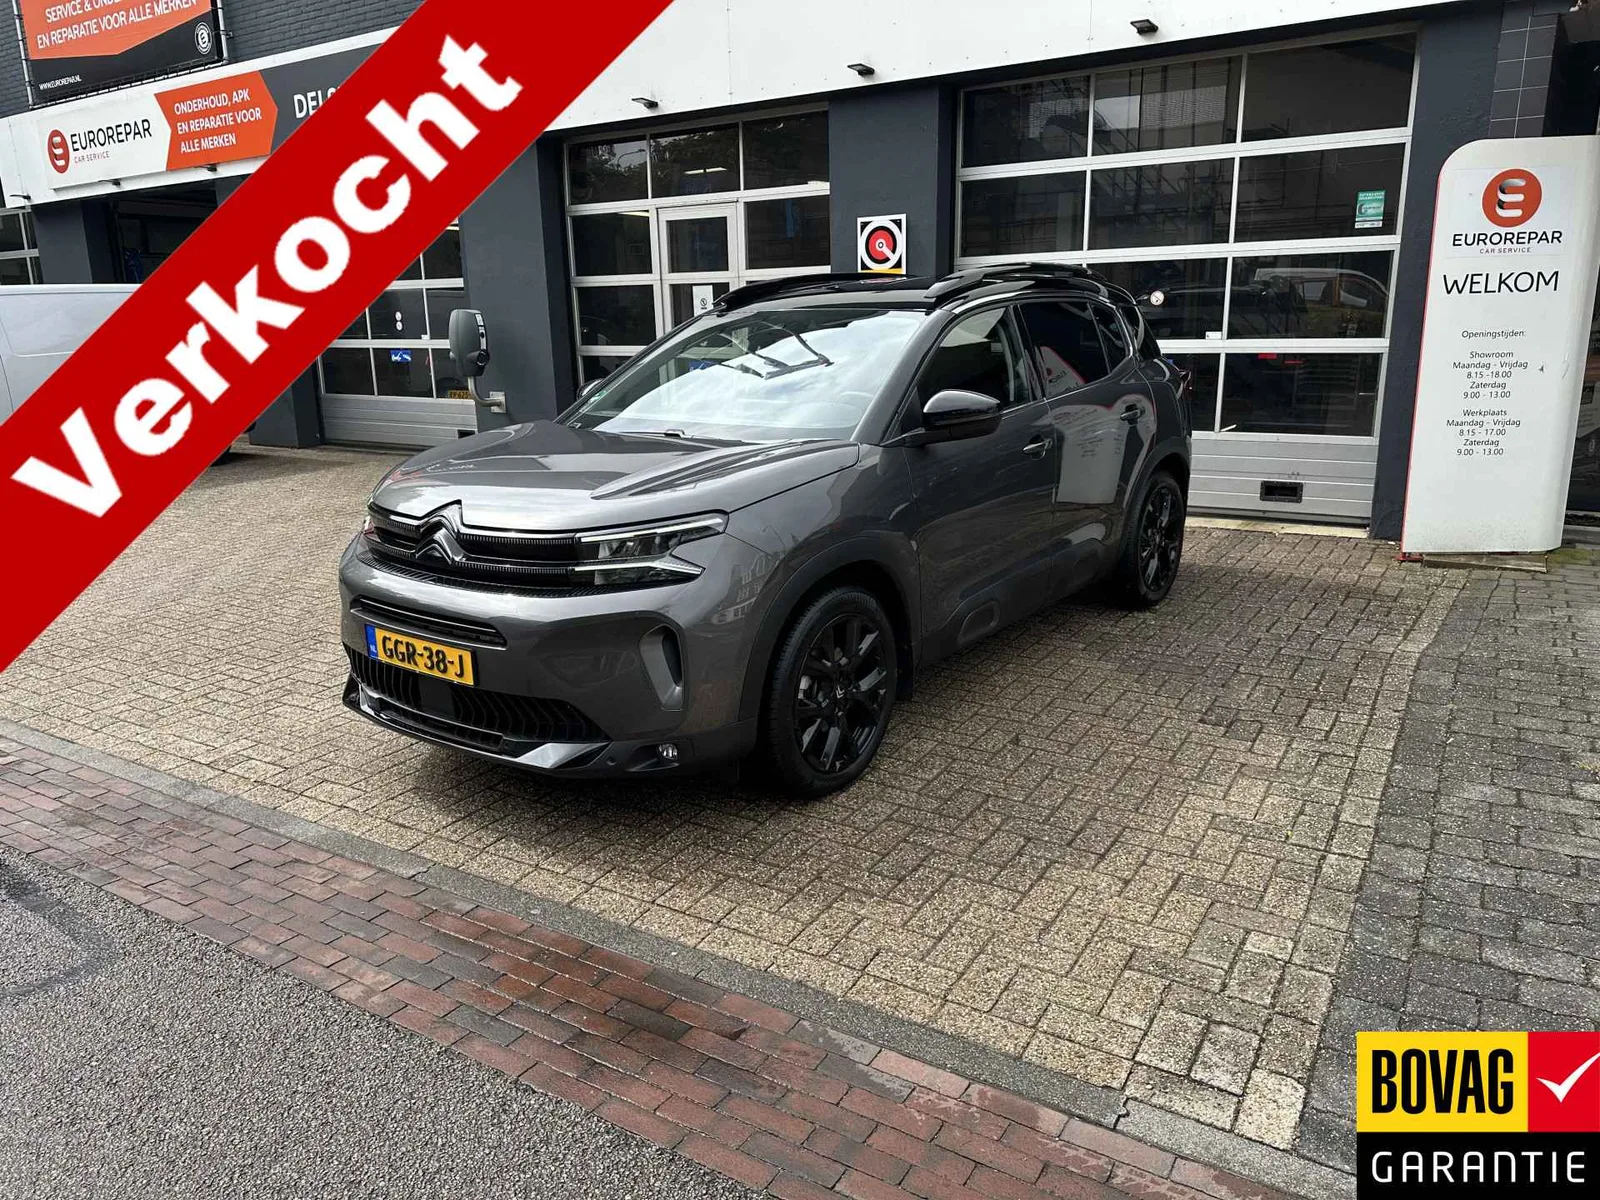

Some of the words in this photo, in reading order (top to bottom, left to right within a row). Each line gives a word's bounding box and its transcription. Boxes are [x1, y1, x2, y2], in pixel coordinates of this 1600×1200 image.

[45, 0, 83, 23] SERVICE
[36, 33, 51, 49] EN
[50, 19, 99, 45] REPARATIE
[98, 11, 128, 31] VOOR
[128, 3, 153, 24] ALLE
[174, 94, 231, 115] ONDERHOUD,
[232, 88, 251, 104] APK
[177, 121, 189, 135] EN
[189, 113, 235, 133] REPARATIE
[235, 107, 262, 124] VOOR
[70, 118, 152, 152] EUROREPAR
[180, 139, 201, 154] ALLE
[200, 133, 237, 150] MERKEN
[73, 154, 86, 164] CAR
[86, 150, 111, 162] SERVICE
[1452, 230, 1563, 247] EUROREPAR
[1497, 246, 1532, 254] SERVICE
[1443, 270, 1559, 295] WELKOM
[1469, 350, 1514, 359] Showroom
[1452, 361, 1491, 370] Maandag
[1499, 360, 1529, 370] Vrijdag
[1466, 371, 1484, 379] 8.15
[1469, 381, 1507, 390] Zaterdag
[1463, 391, 1480, 399] 9.00
[1489, 390, 1511, 398] 13.00
[1462, 409, 1508, 418] Werkplaats
[1446, 419, 1484, 428] Maandag
[1492, 418, 1521, 428] Vrijdag
[1458, 428, 1476, 437] 8.15
[1485, 428, 1506, 436] 17.00
[1463, 438, 1500, 448] Zaterdag
[1456, 448, 1474, 456] 9.00
[1482, 447, 1504, 456] 13.00
[381, 634, 465, 678] GGR-38-J
